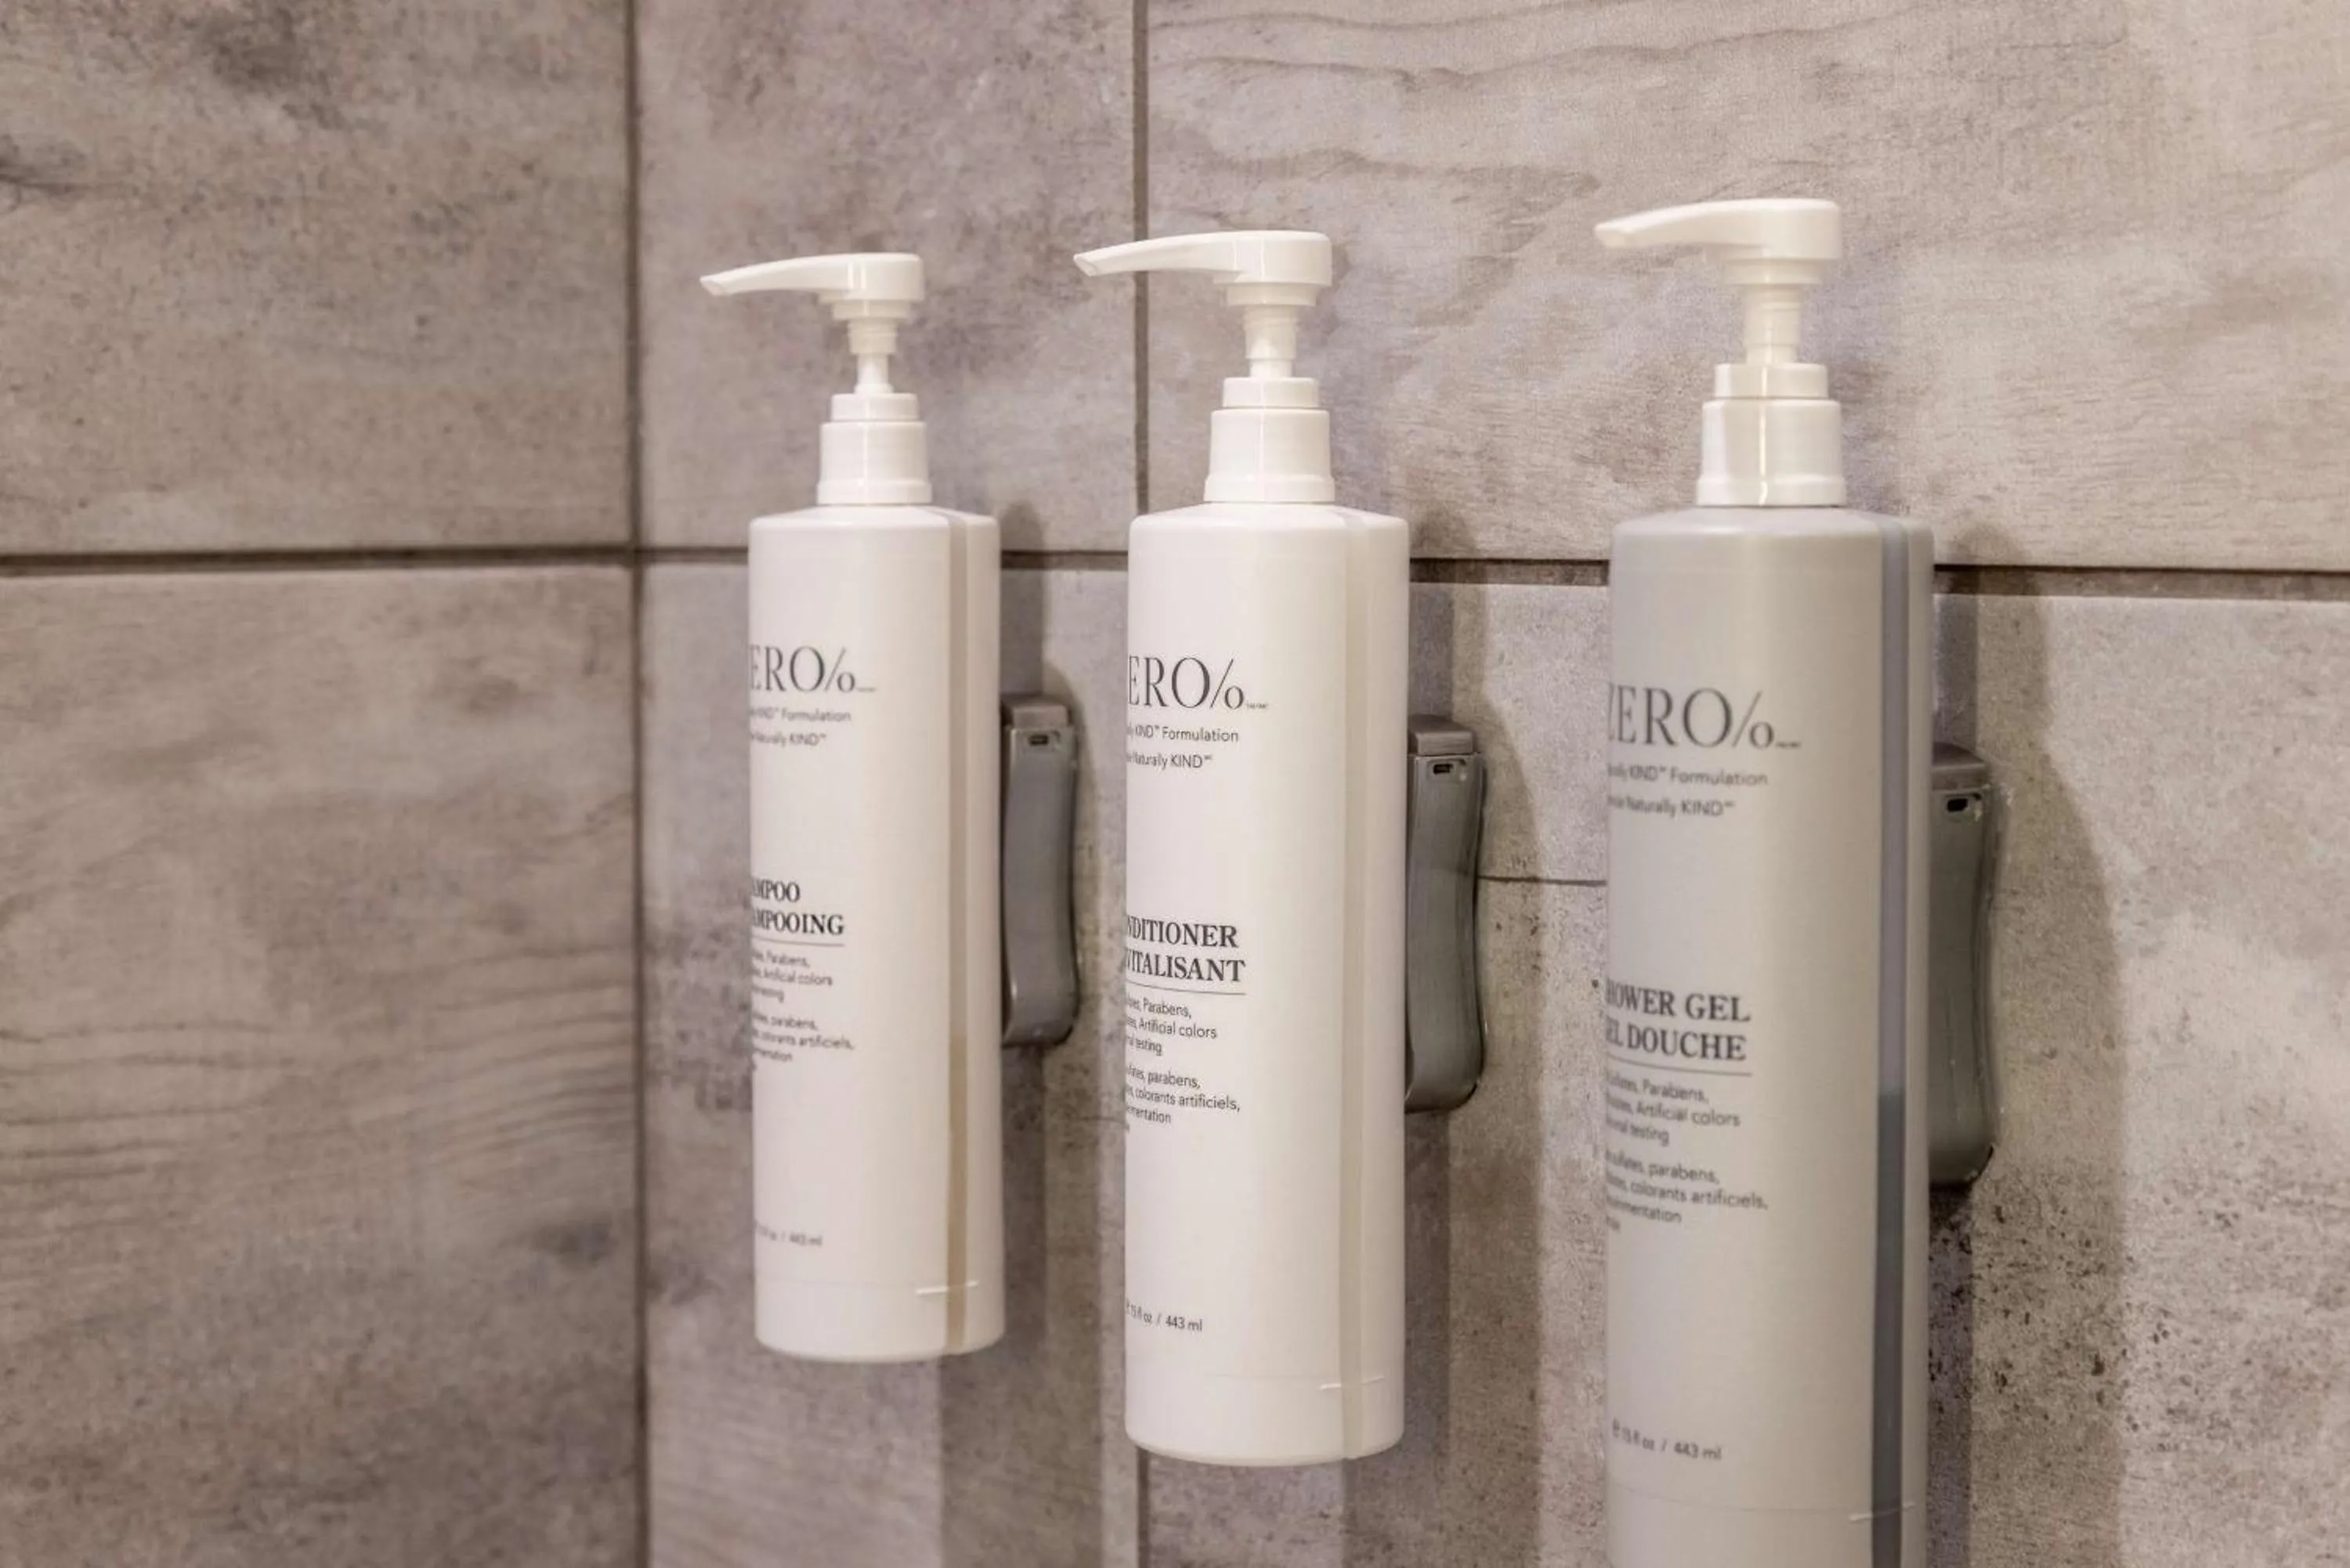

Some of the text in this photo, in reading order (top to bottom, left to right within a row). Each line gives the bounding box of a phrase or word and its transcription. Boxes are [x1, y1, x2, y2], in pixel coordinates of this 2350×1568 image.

[781, 707, 852, 722] Formulation
[1162, 726, 1239, 742] Formulation
[1670, 766, 1768, 786] Formulation
[1143, 996, 1191, 1018] Parabens,
[1685, 992, 1752, 1022] GEL
[1139, 1017, 1176, 1035] Artificial
[1178, 1024, 1217, 1039] colors
[1627, 1021, 1747, 1061] DOUCHE
[1148, 1068, 1201, 1089] parabens,
[1643, 1078, 1709, 1104] Parabens,
[1178, 1093, 1241, 1112] artificiels,
[1690, 1108, 1741, 1128] colors
[1648, 1162, 1720, 1185] parabens,
[1690, 1189, 1769, 1210] artificiels,
[1166, 1314, 1185, 1329] 443
[1188, 1319, 1203, 1331] ml
[1702, 1445, 1722, 1461] ml
